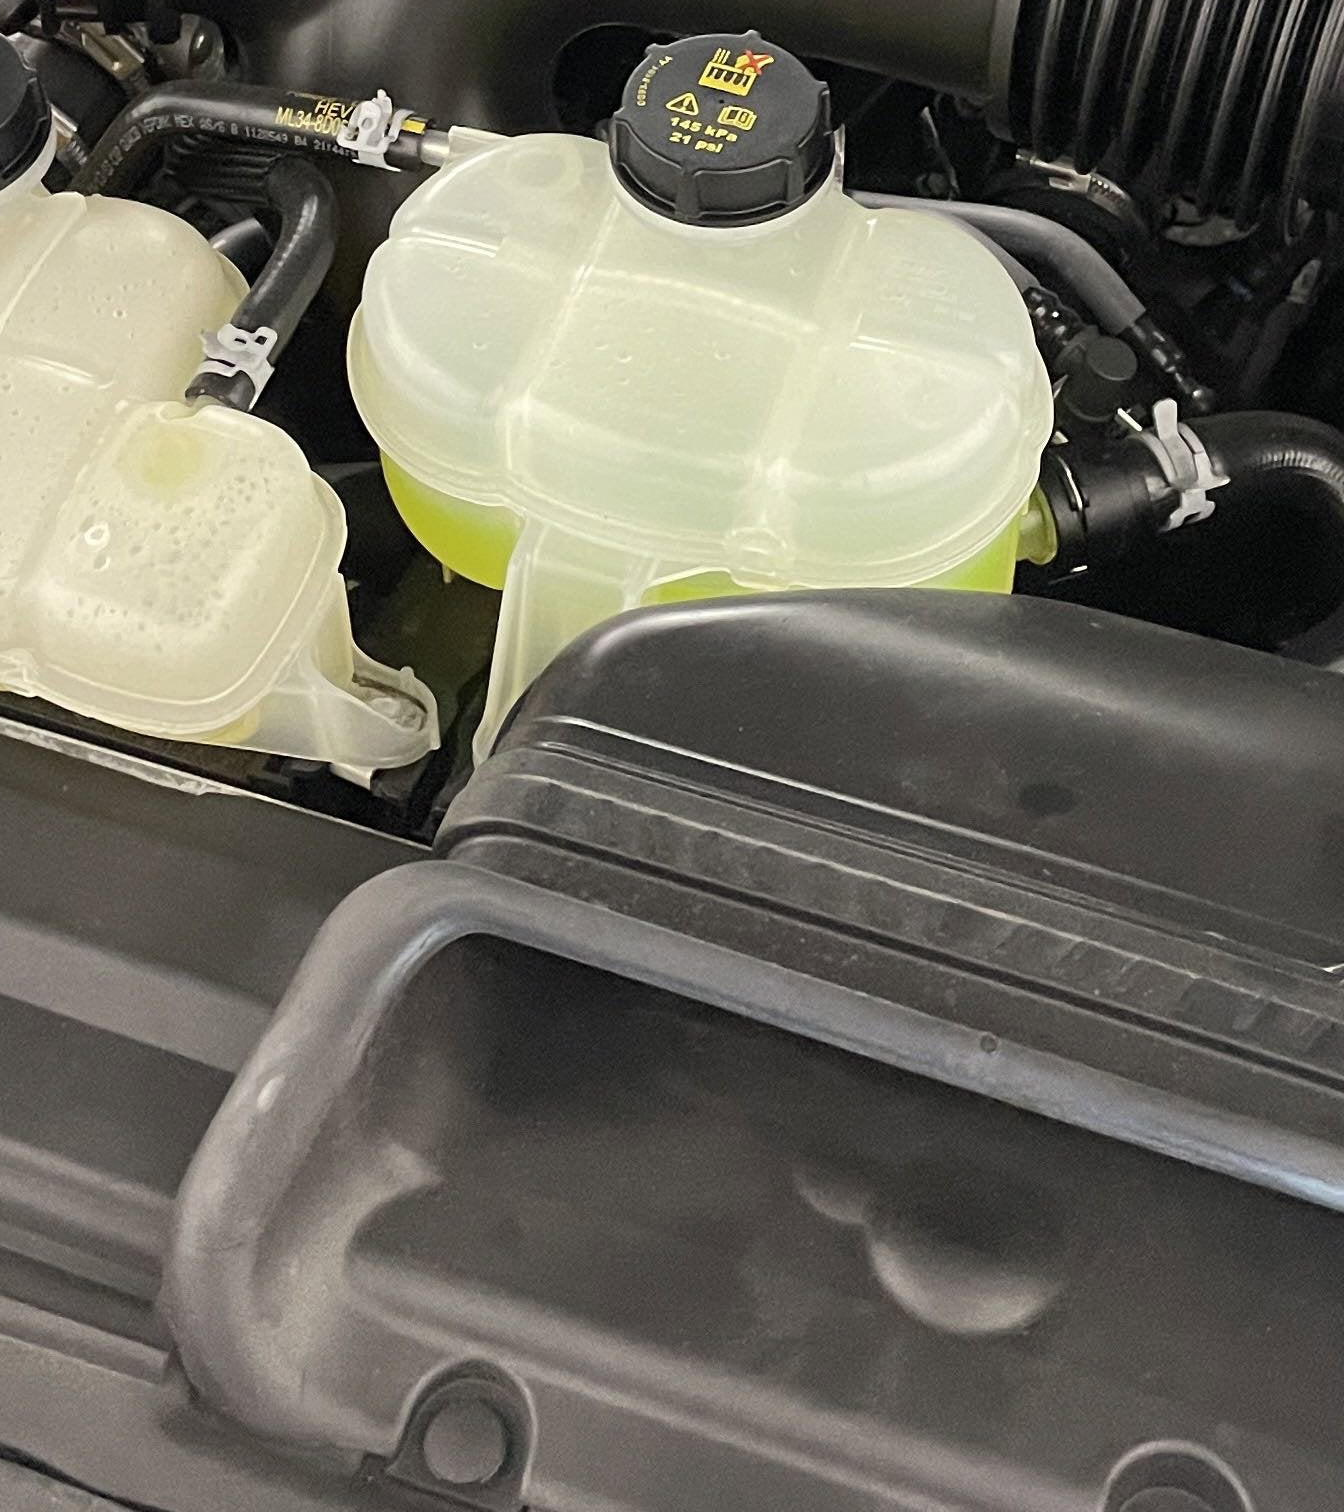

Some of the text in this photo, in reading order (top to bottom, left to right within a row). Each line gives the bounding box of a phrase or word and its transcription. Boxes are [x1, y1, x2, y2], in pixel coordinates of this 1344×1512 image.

[314, 99, 354, 118] HEV
[670, 117, 738, 142] 145 kPa
[669, 132, 723, 153] 21 psi
